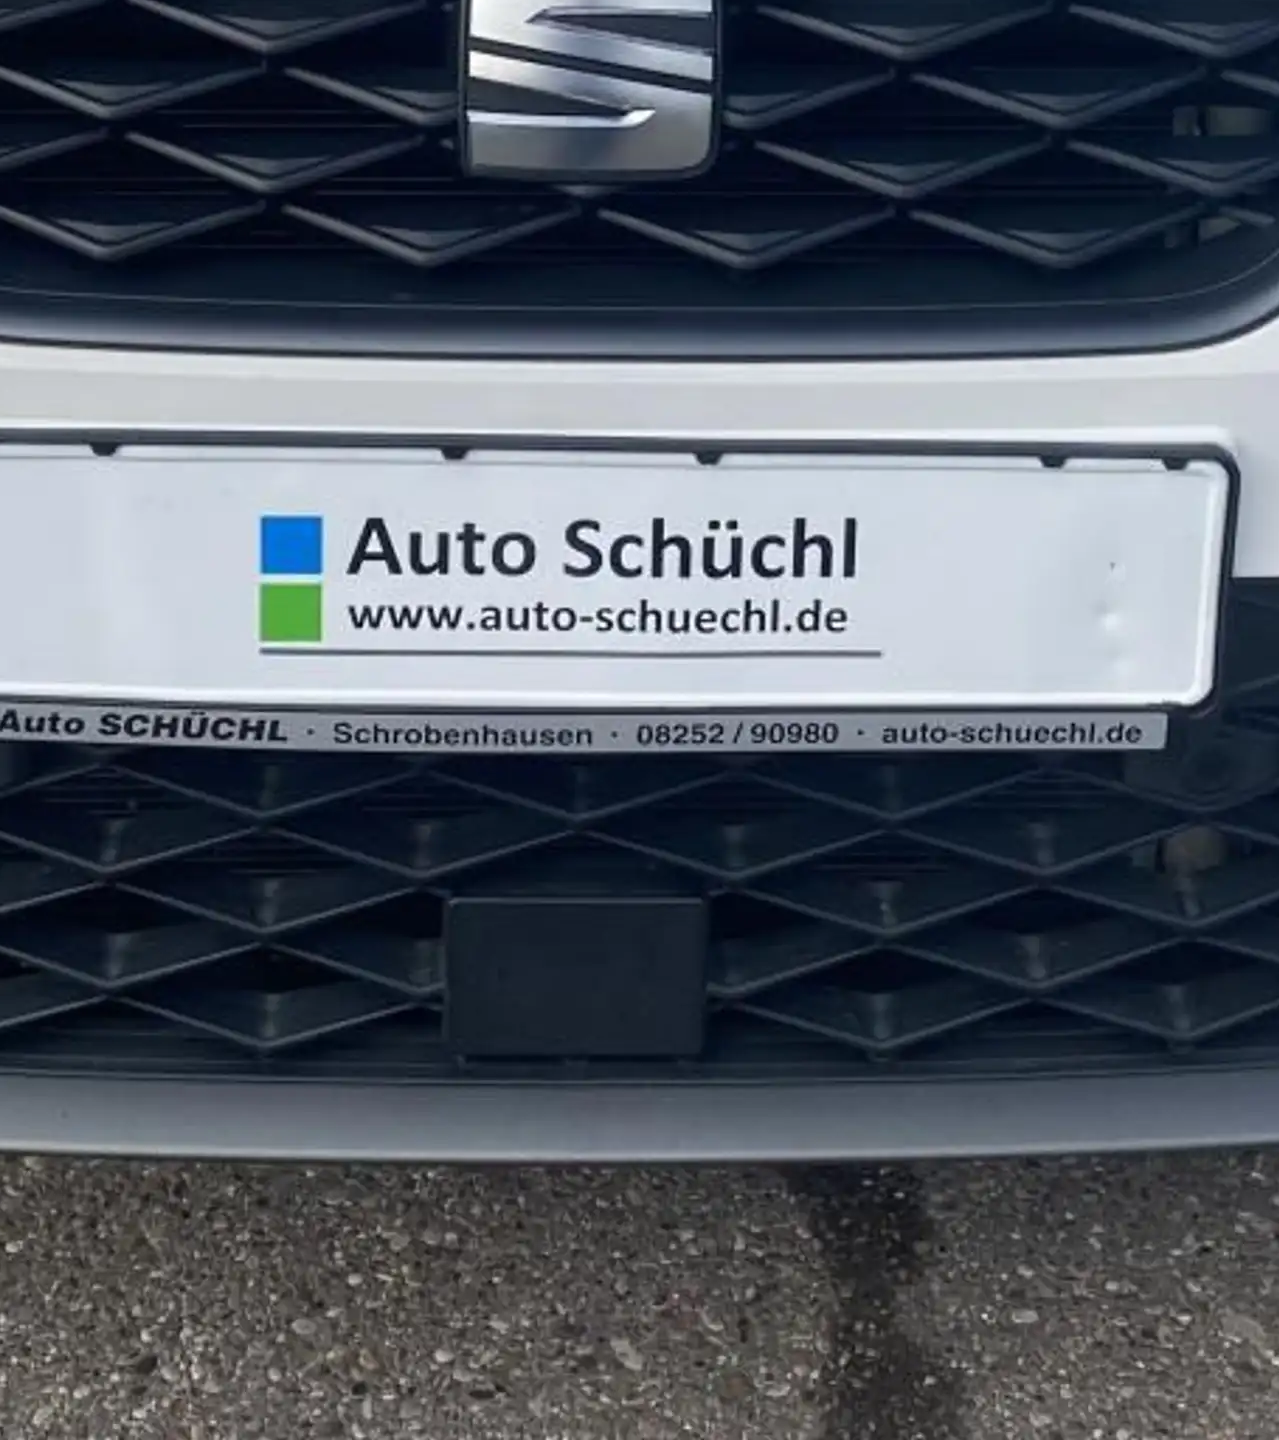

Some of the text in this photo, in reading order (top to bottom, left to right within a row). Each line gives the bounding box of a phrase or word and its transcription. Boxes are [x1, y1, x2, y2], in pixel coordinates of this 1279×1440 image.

[346, 516, 858, 578] Auto Schüchl
[347, 599, 849, 634] www.auto-schuechl.de
[96, 711, 288, 742] SCHÜCHL
[332, 722, 593, 747] Schrobenhausen
[881, 723, 1144, 746] auto-schuechl.de
